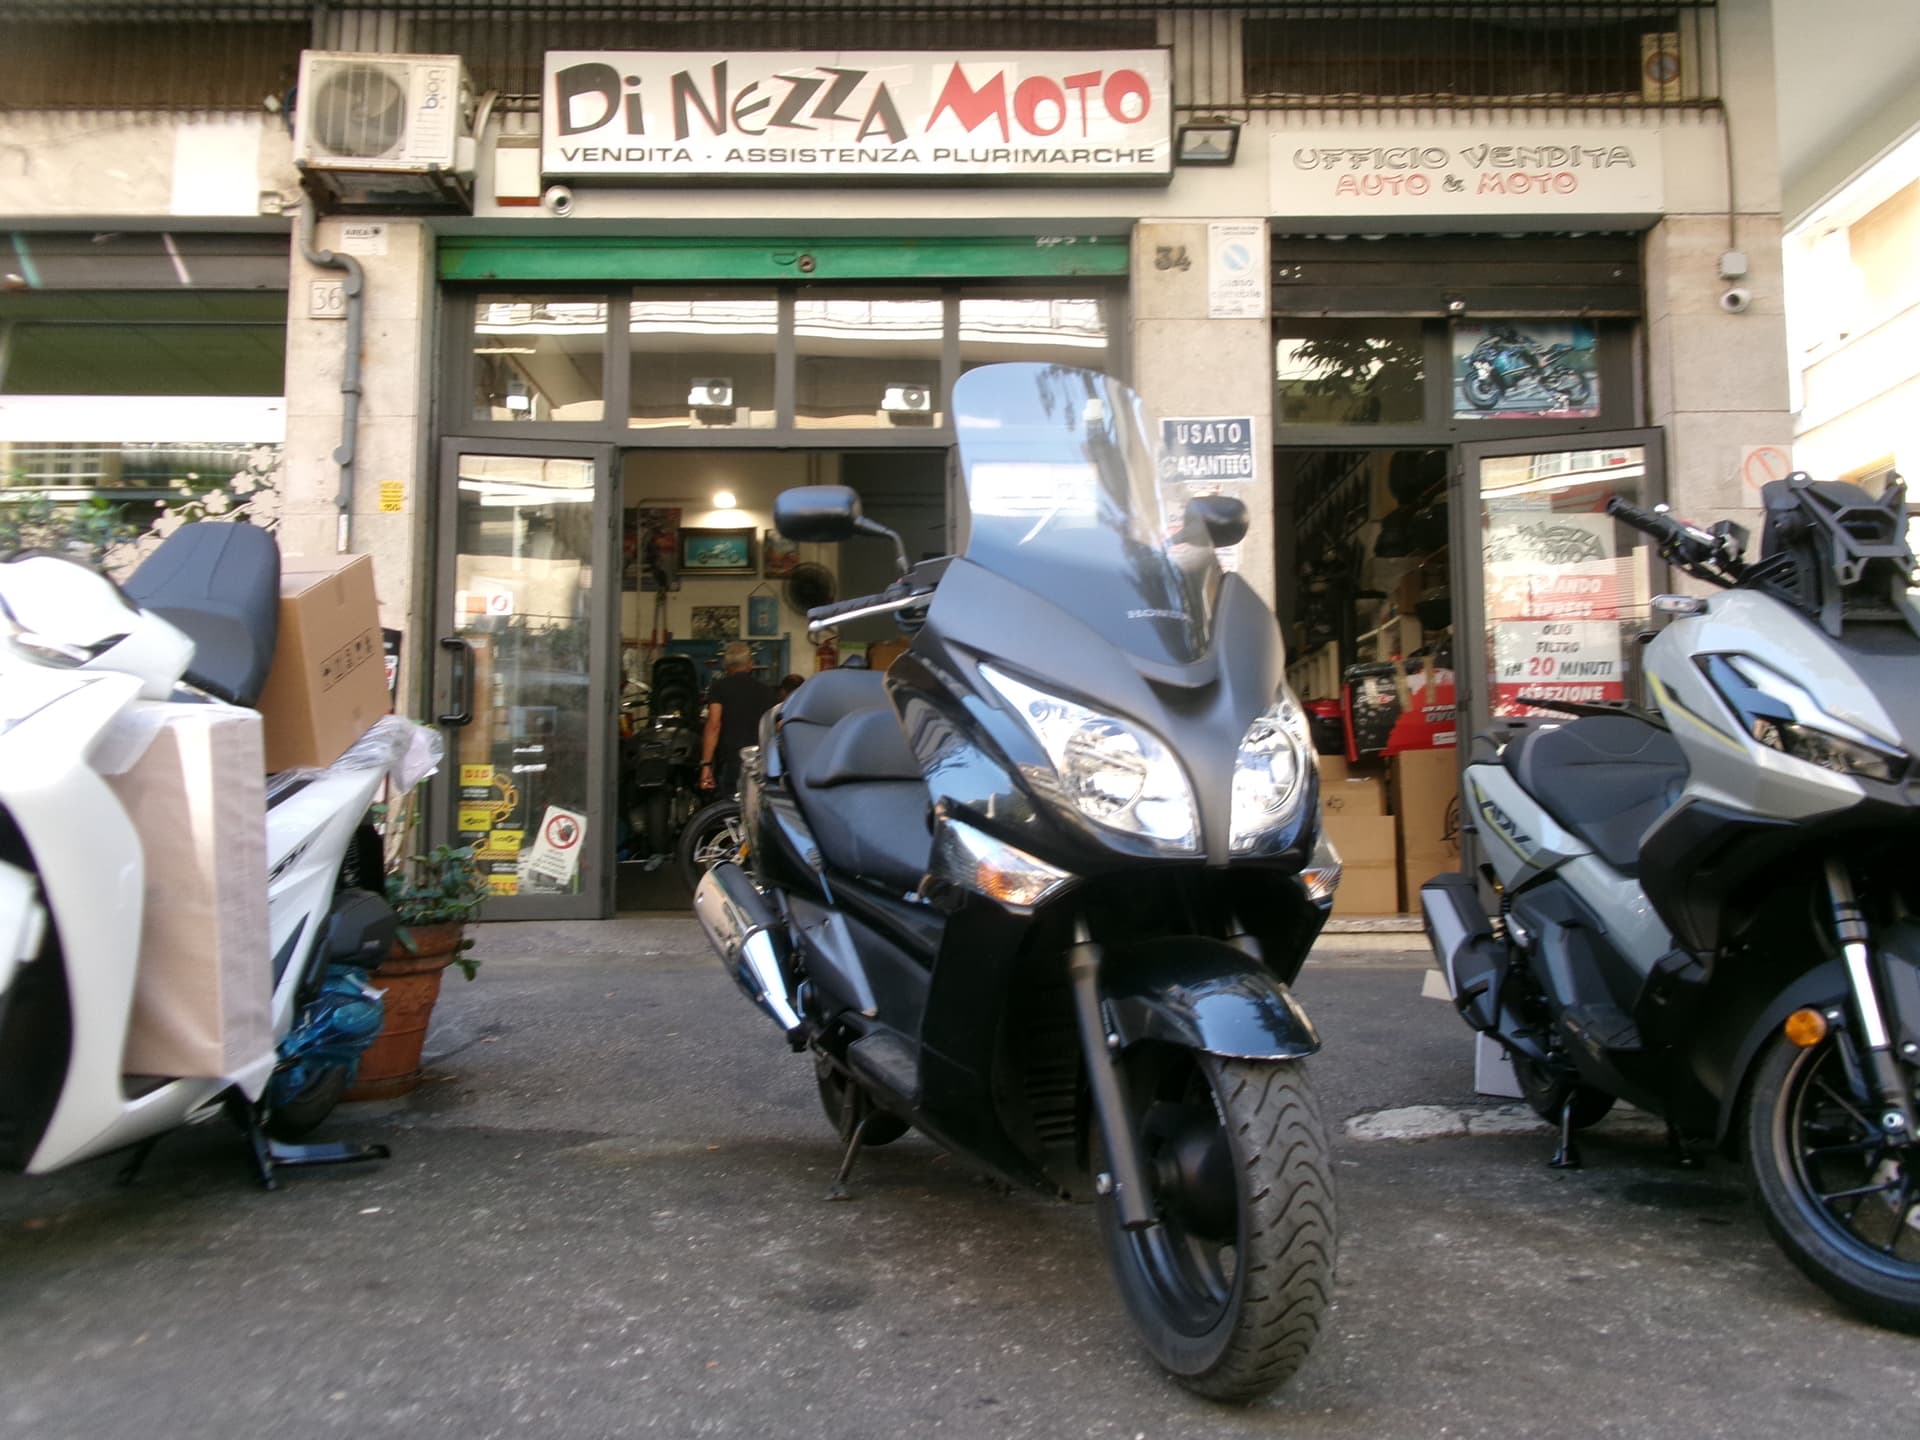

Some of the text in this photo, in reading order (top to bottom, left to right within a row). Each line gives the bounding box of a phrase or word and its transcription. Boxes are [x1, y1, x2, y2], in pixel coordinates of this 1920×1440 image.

[555, 61, 645, 137] Di
[561, 147, 1156, 163] VENDITA ASSISTENZA PLURIMARCHE
[1292, 143, 1637, 170] UFFICIO VENDITA
[1335, 171, 1579, 197] AUTO & MOTO
[1155, 246, 1191, 271] 34
[313, 286, 344, 310] 36
[1177, 423, 1242, 444] USATO
[1536, 641, 1580, 653] FILTRO
[1528, 657, 1555, 676] 20
[1559, 661, 1613, 676] MINUTI
